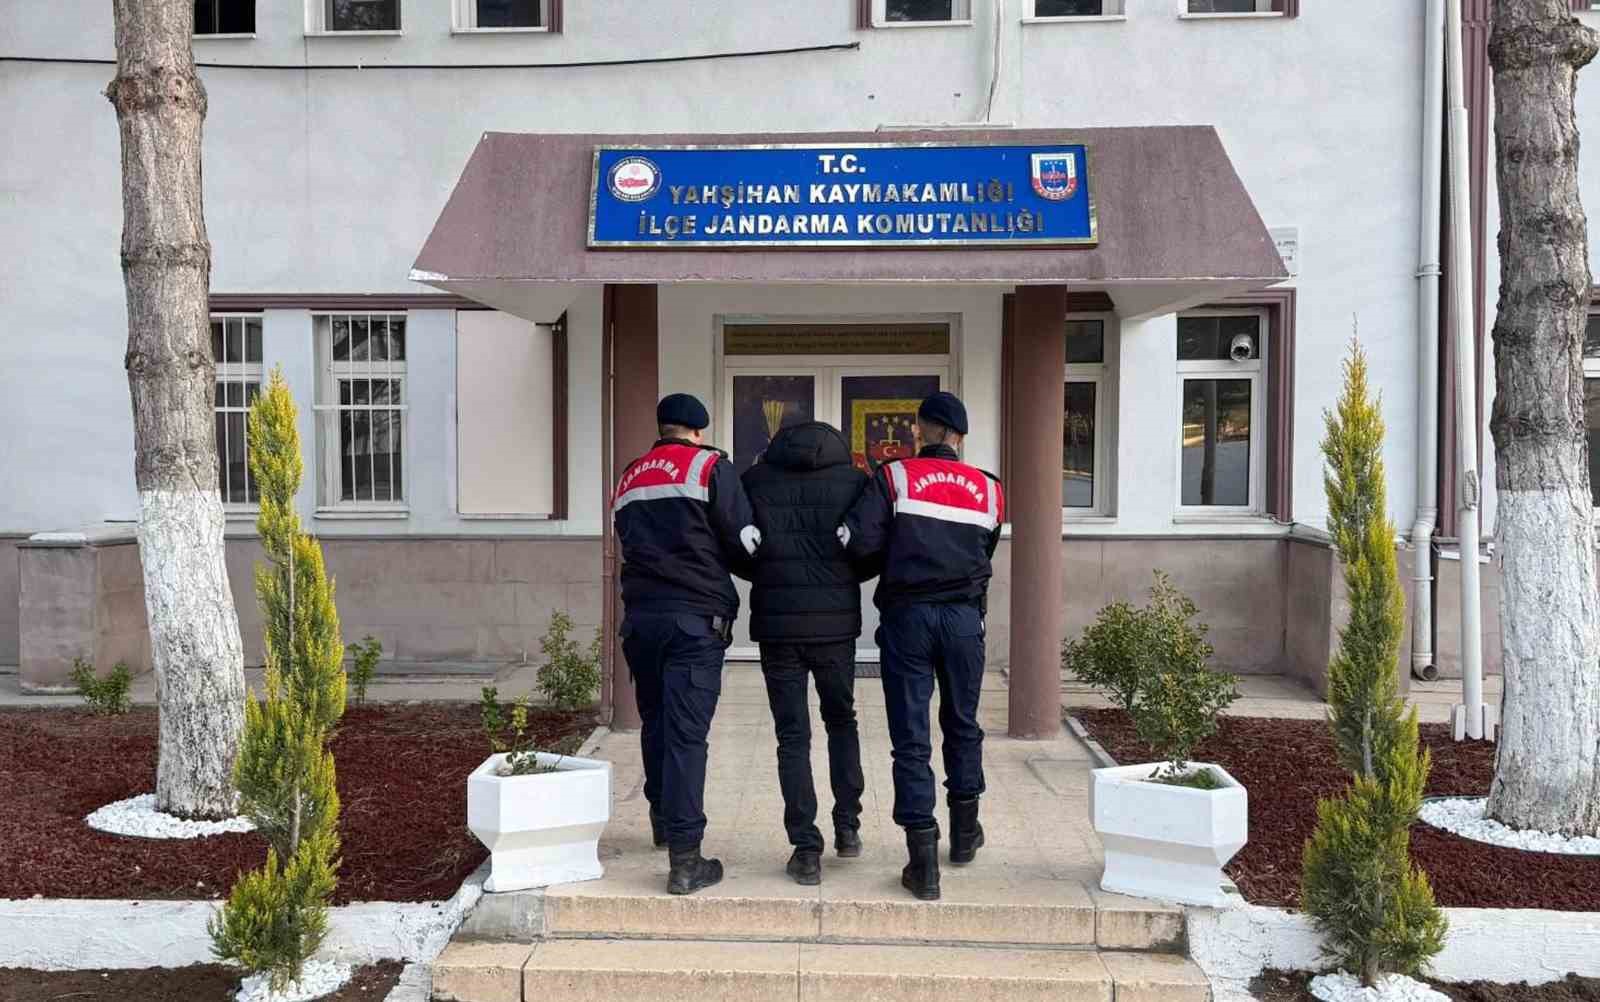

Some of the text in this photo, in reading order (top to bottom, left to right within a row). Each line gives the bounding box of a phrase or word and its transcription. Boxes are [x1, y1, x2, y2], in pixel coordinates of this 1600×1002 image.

[818, 154, 866, 174] T.C.
[669, 182, 800, 208] YAHŞİHAN
[809, 178, 1014, 204] KAYMAKAMLIĞI
[638, 209, 1045, 239] İLÇE JANDARMA KOMUTANLIĞI
[623, 459, 679, 491] JANDARMA
[914, 471, 984, 504] JANDARMA
